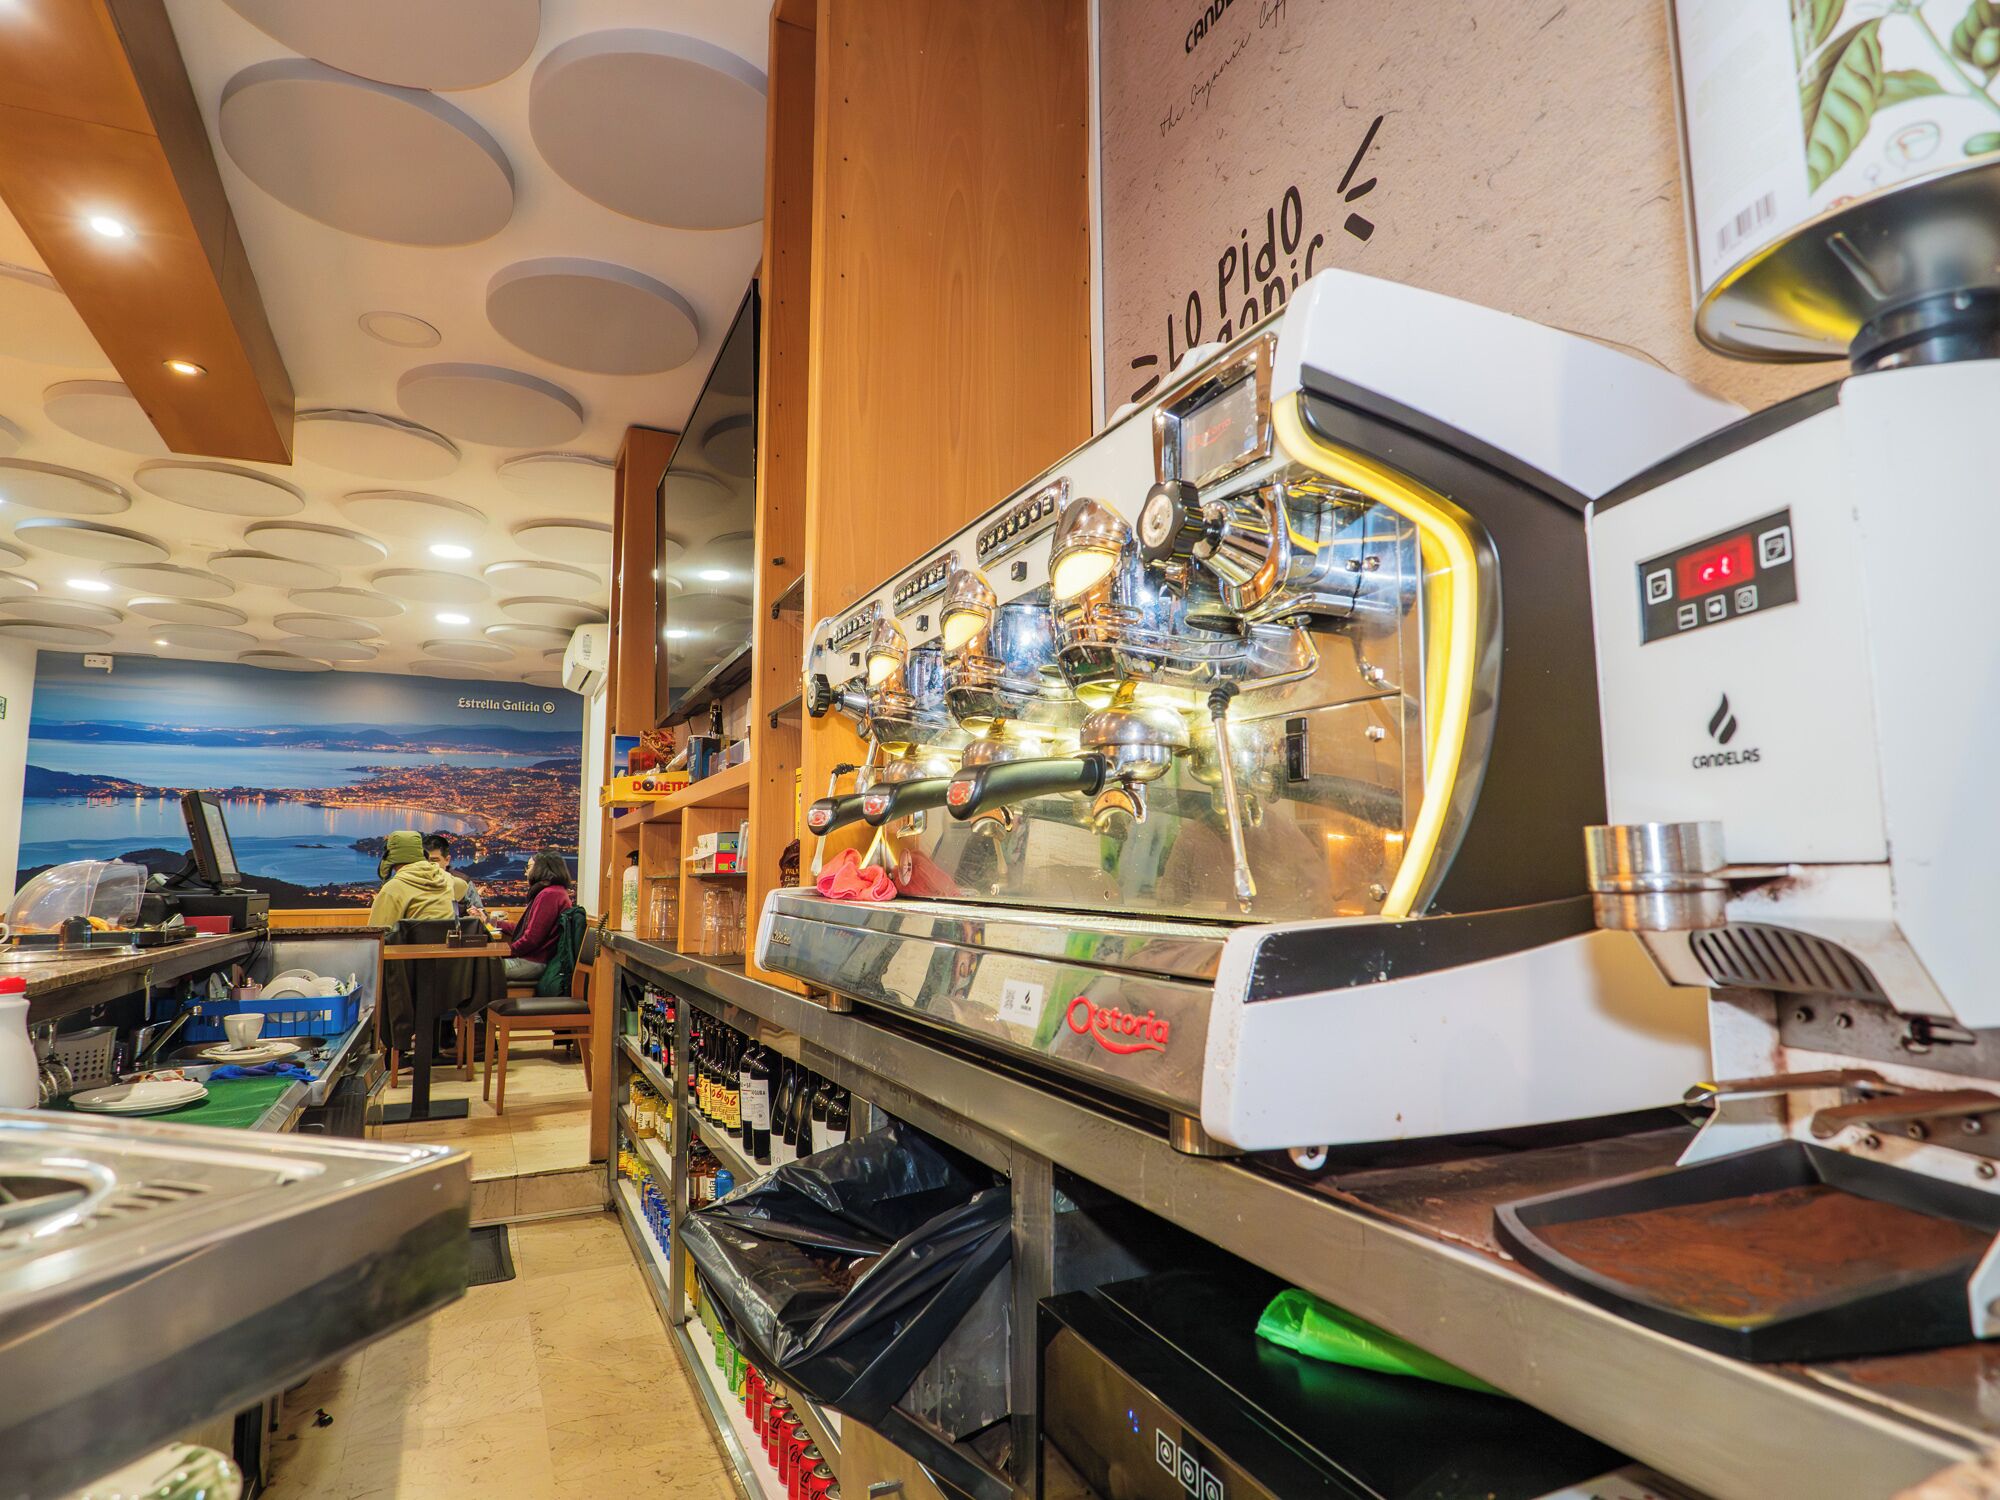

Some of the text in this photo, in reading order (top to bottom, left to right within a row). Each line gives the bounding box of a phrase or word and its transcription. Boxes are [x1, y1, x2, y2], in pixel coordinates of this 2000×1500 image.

[1185, 0, 1234, 54] CAND
[457, 697, 540, 712] Estrella Galicia
[1692, 748, 1760, 769] CANDELAS
